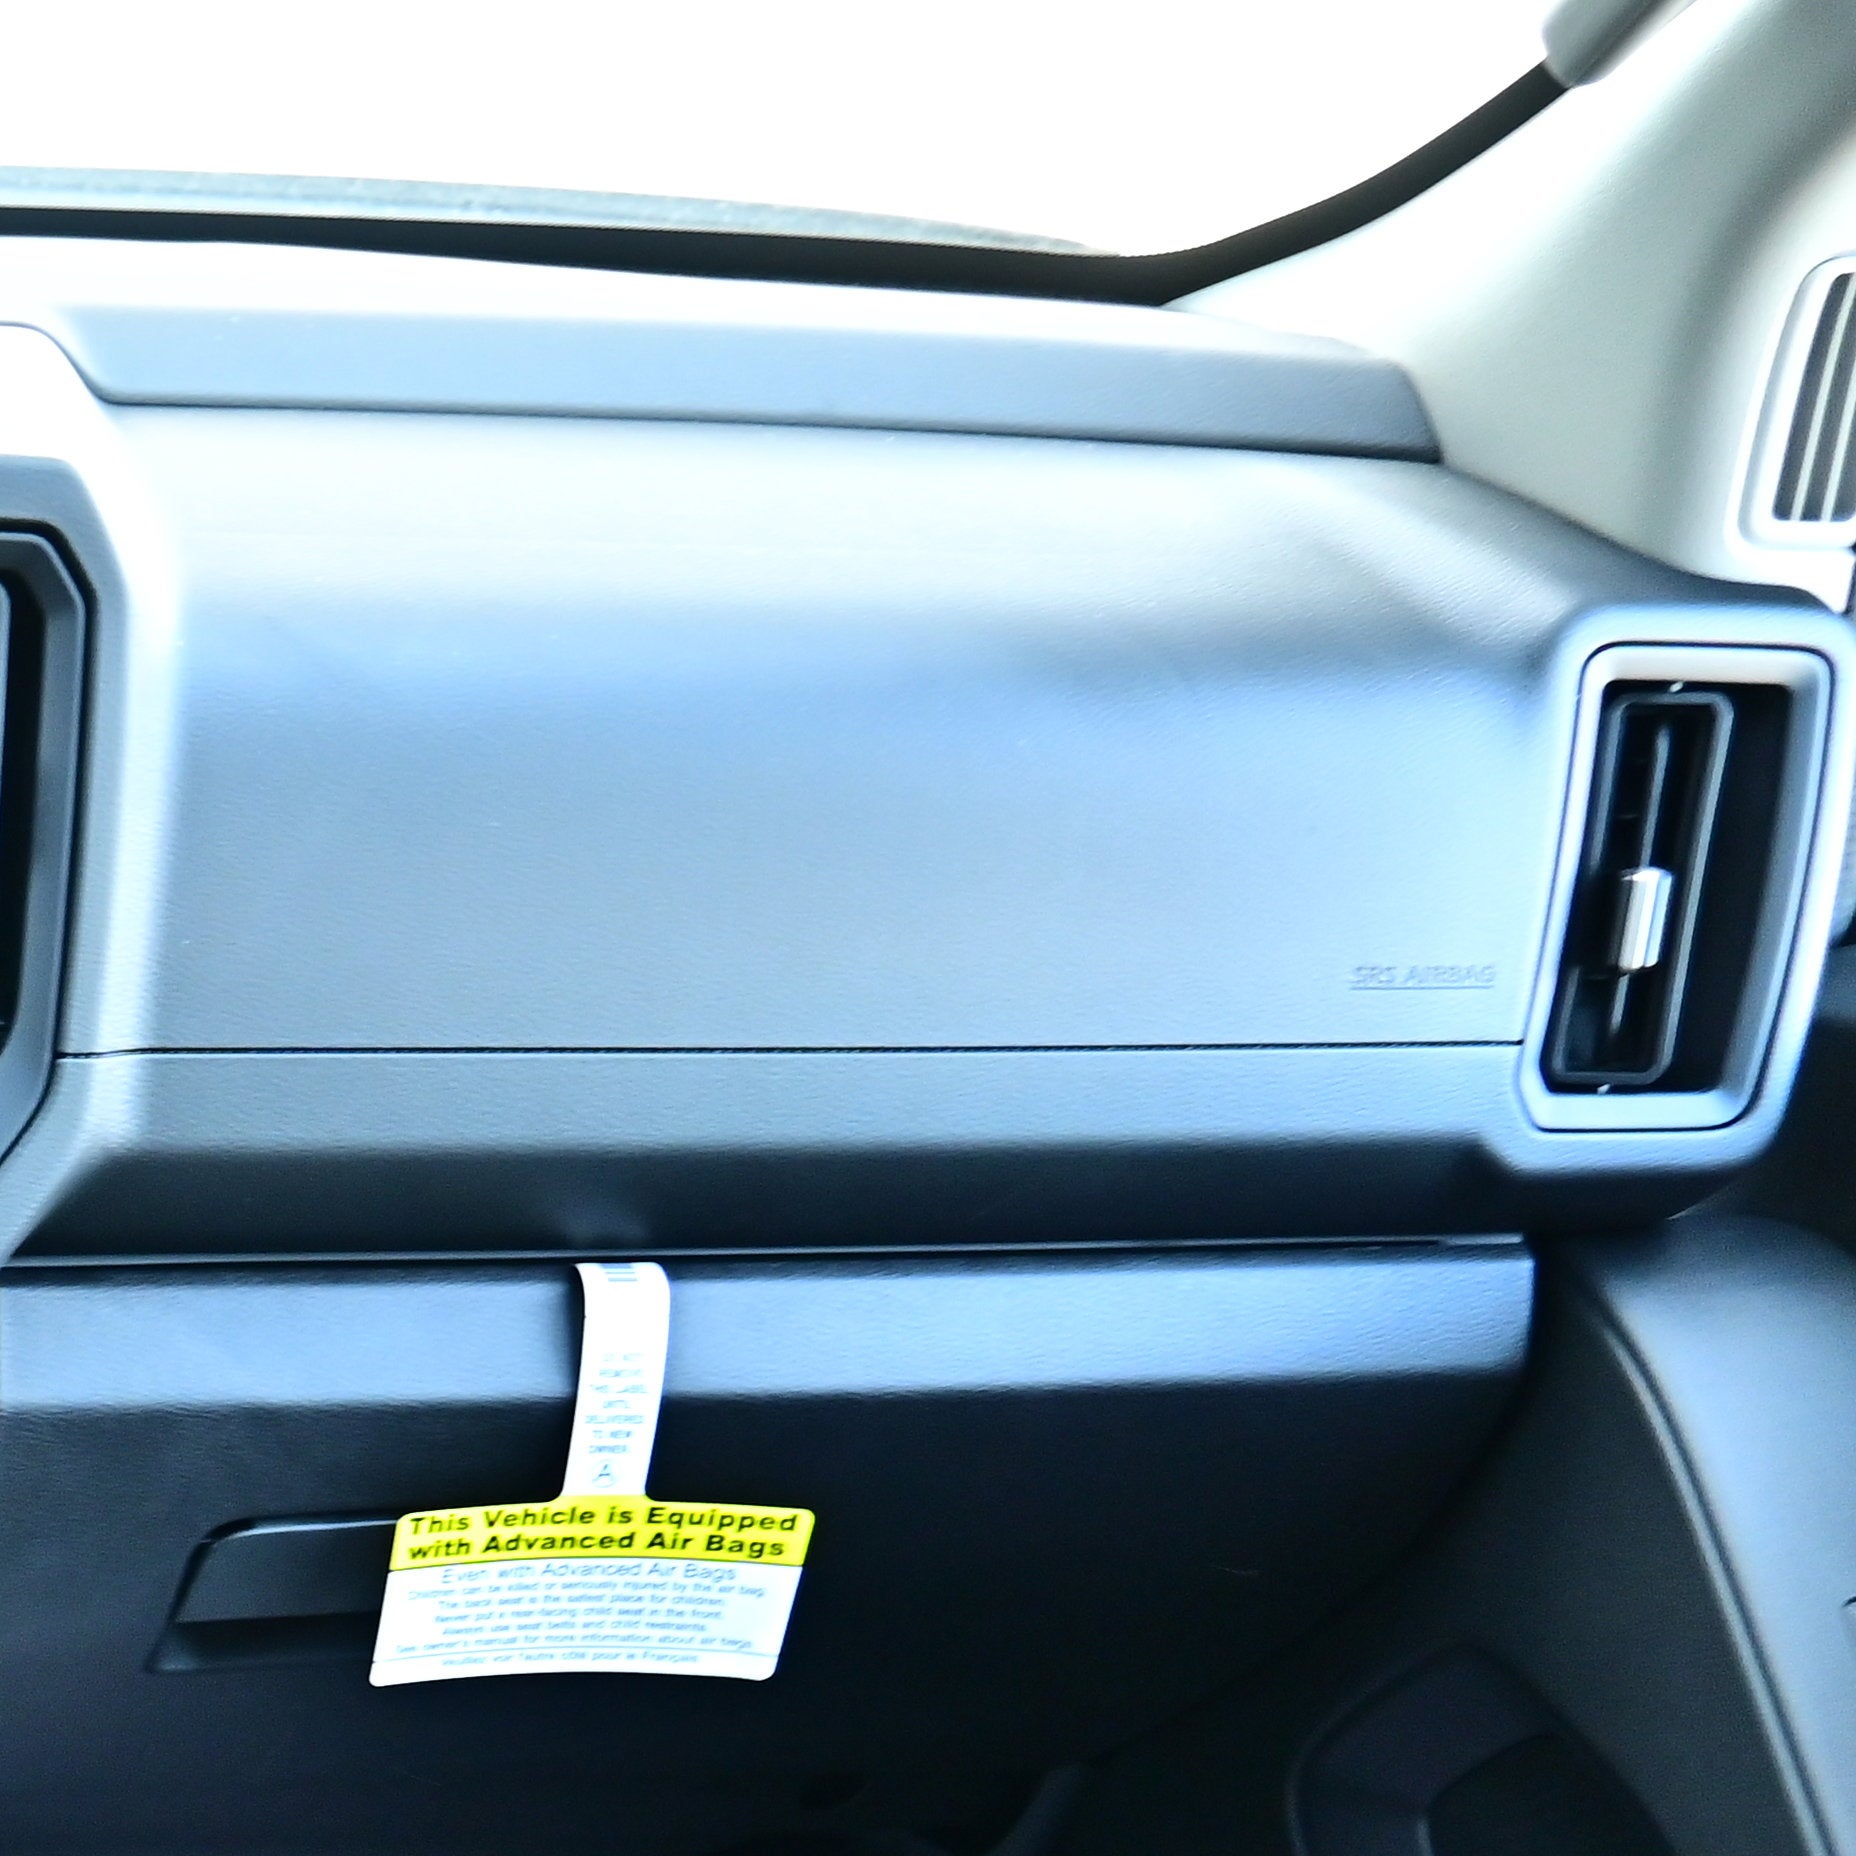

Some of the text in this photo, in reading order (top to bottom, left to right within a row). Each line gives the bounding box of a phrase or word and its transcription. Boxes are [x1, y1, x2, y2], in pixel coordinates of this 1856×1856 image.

[409, 1505, 799, 1536] This Vehicle is Equipped
[408, 1531, 786, 1561] with Advanced Air Bags
[540, 1562, 643, 1577] Advanced
[646, 1562, 678, 1577] Air
[683, 1563, 737, 1585] Bags
